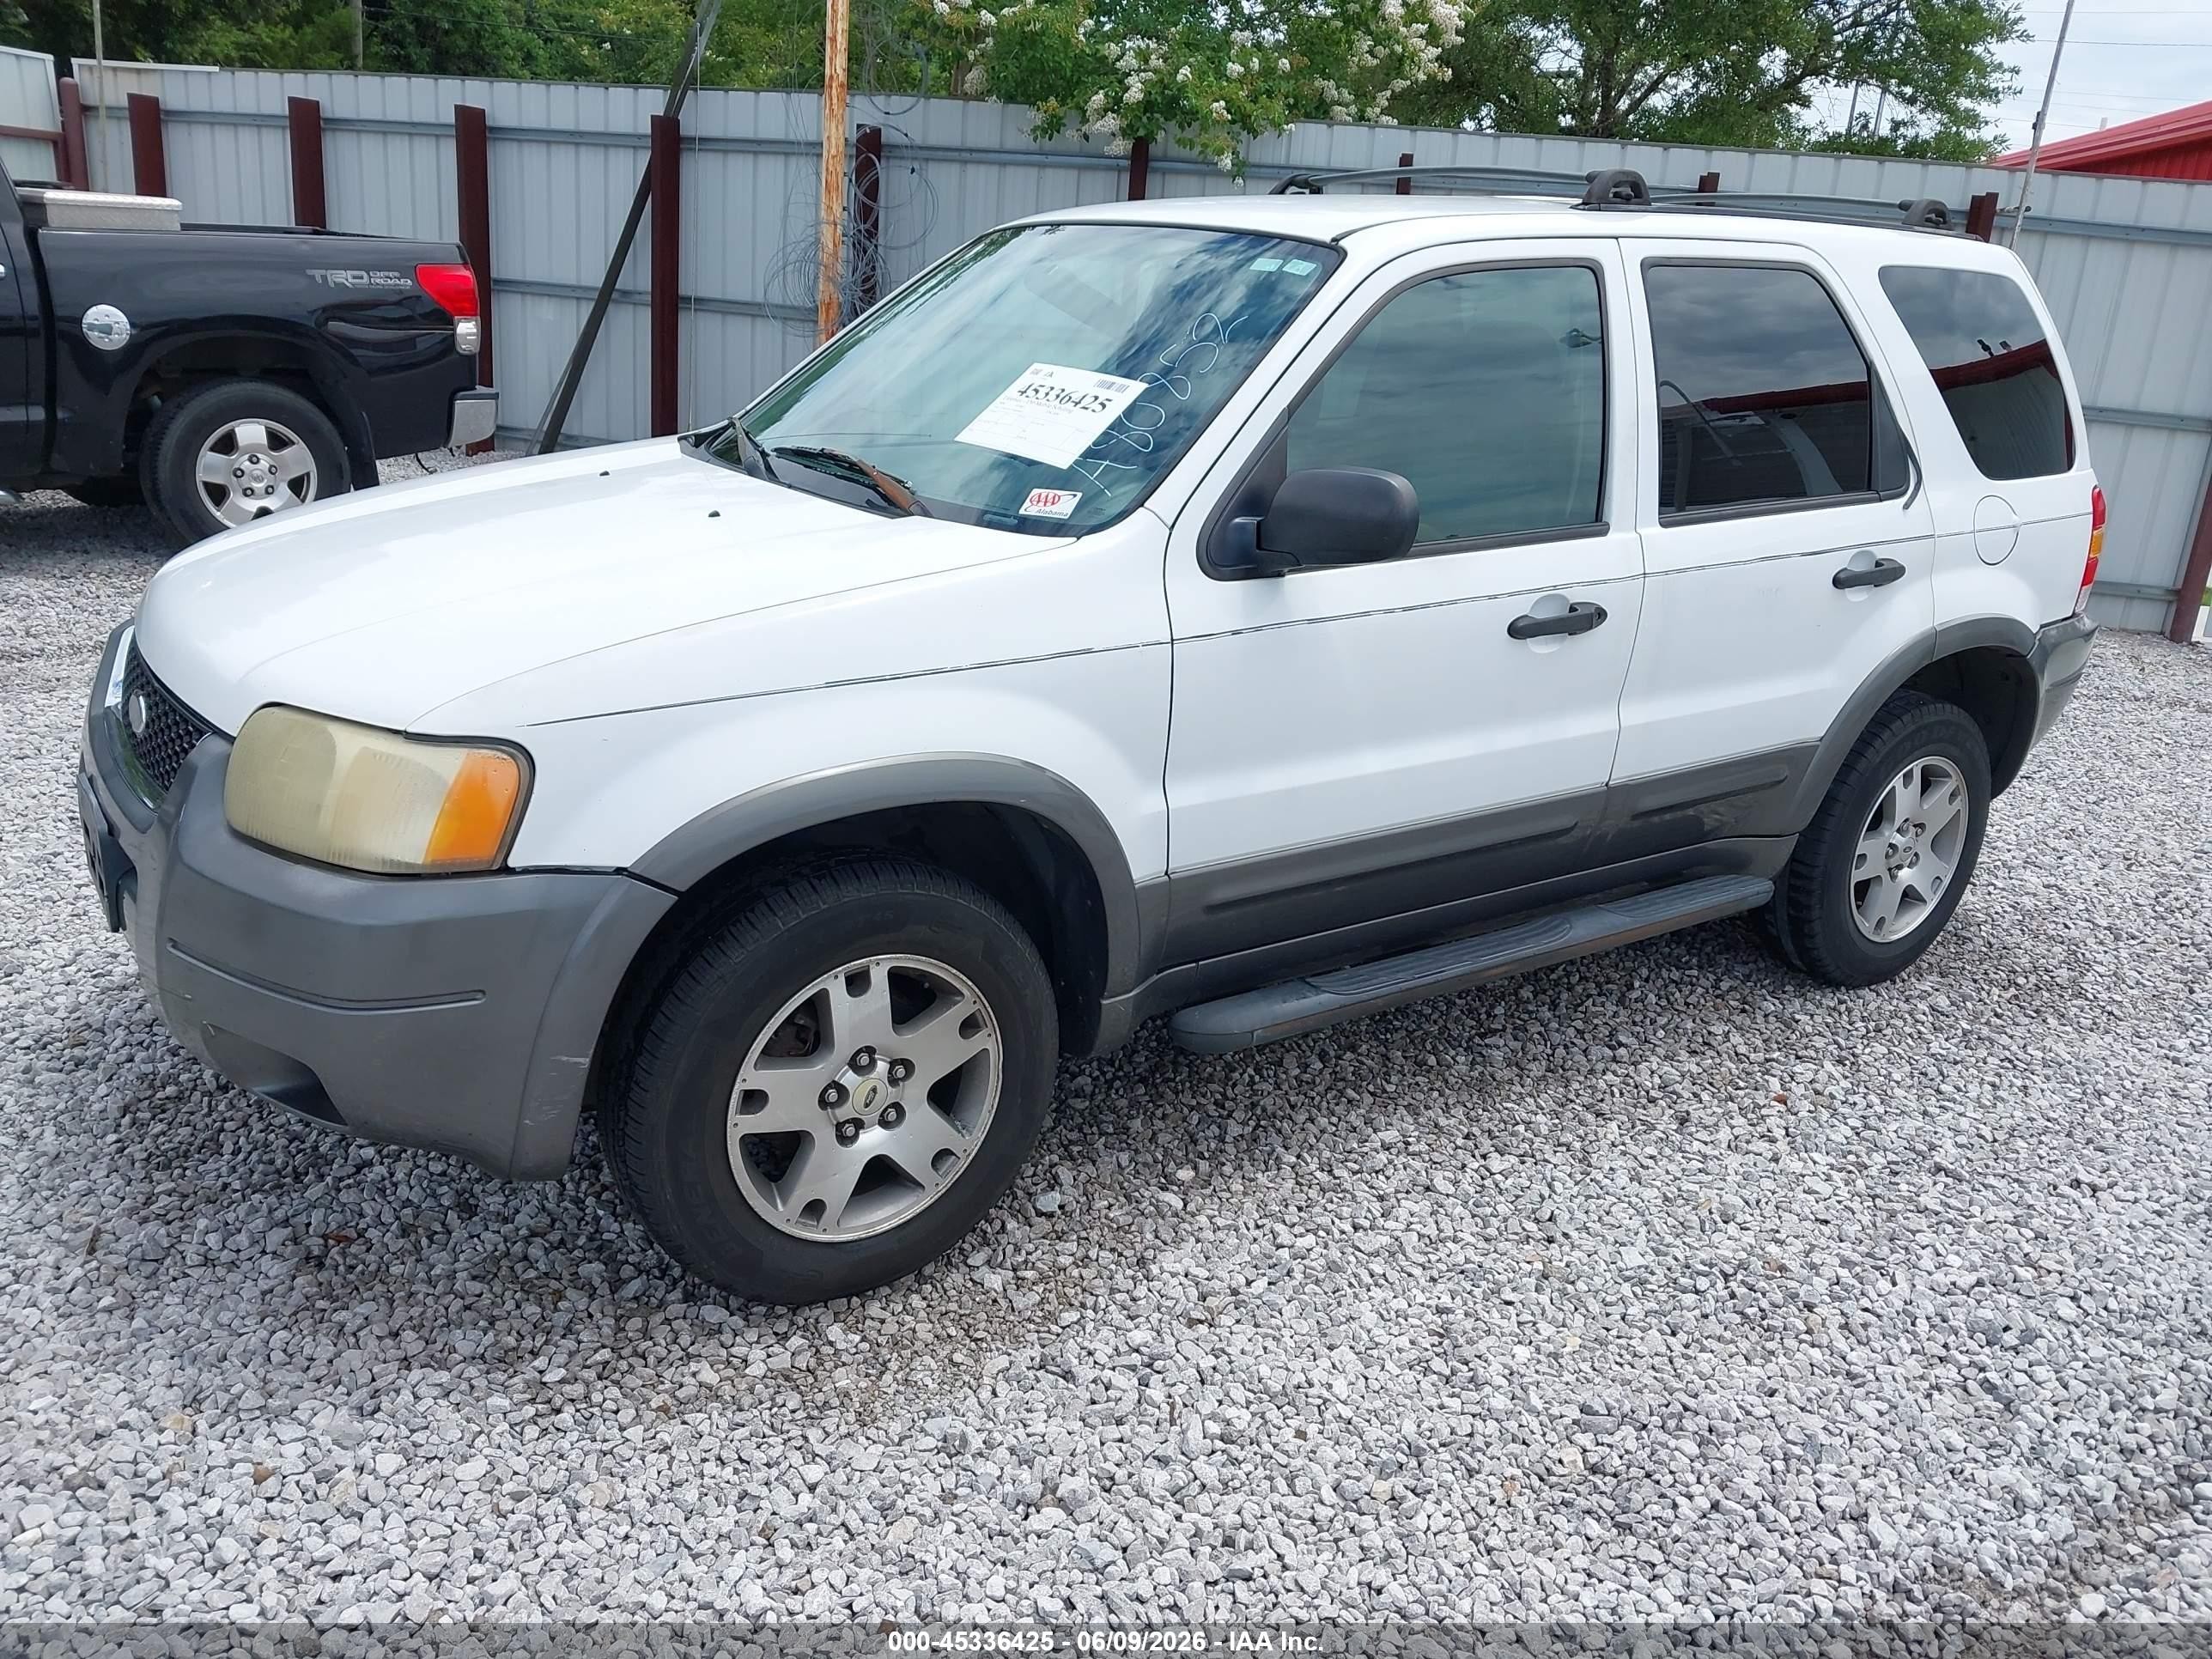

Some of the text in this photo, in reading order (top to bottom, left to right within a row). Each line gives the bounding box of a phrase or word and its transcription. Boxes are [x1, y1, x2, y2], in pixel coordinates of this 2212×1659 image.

[306, 269, 369, 289] TRD
[371, 277, 412, 286] ROAD
[1018, 382, 1114, 413] 45336425
[1030, 491, 1060, 507] AAA
[1036, 508, 1069, 517] Alabama
